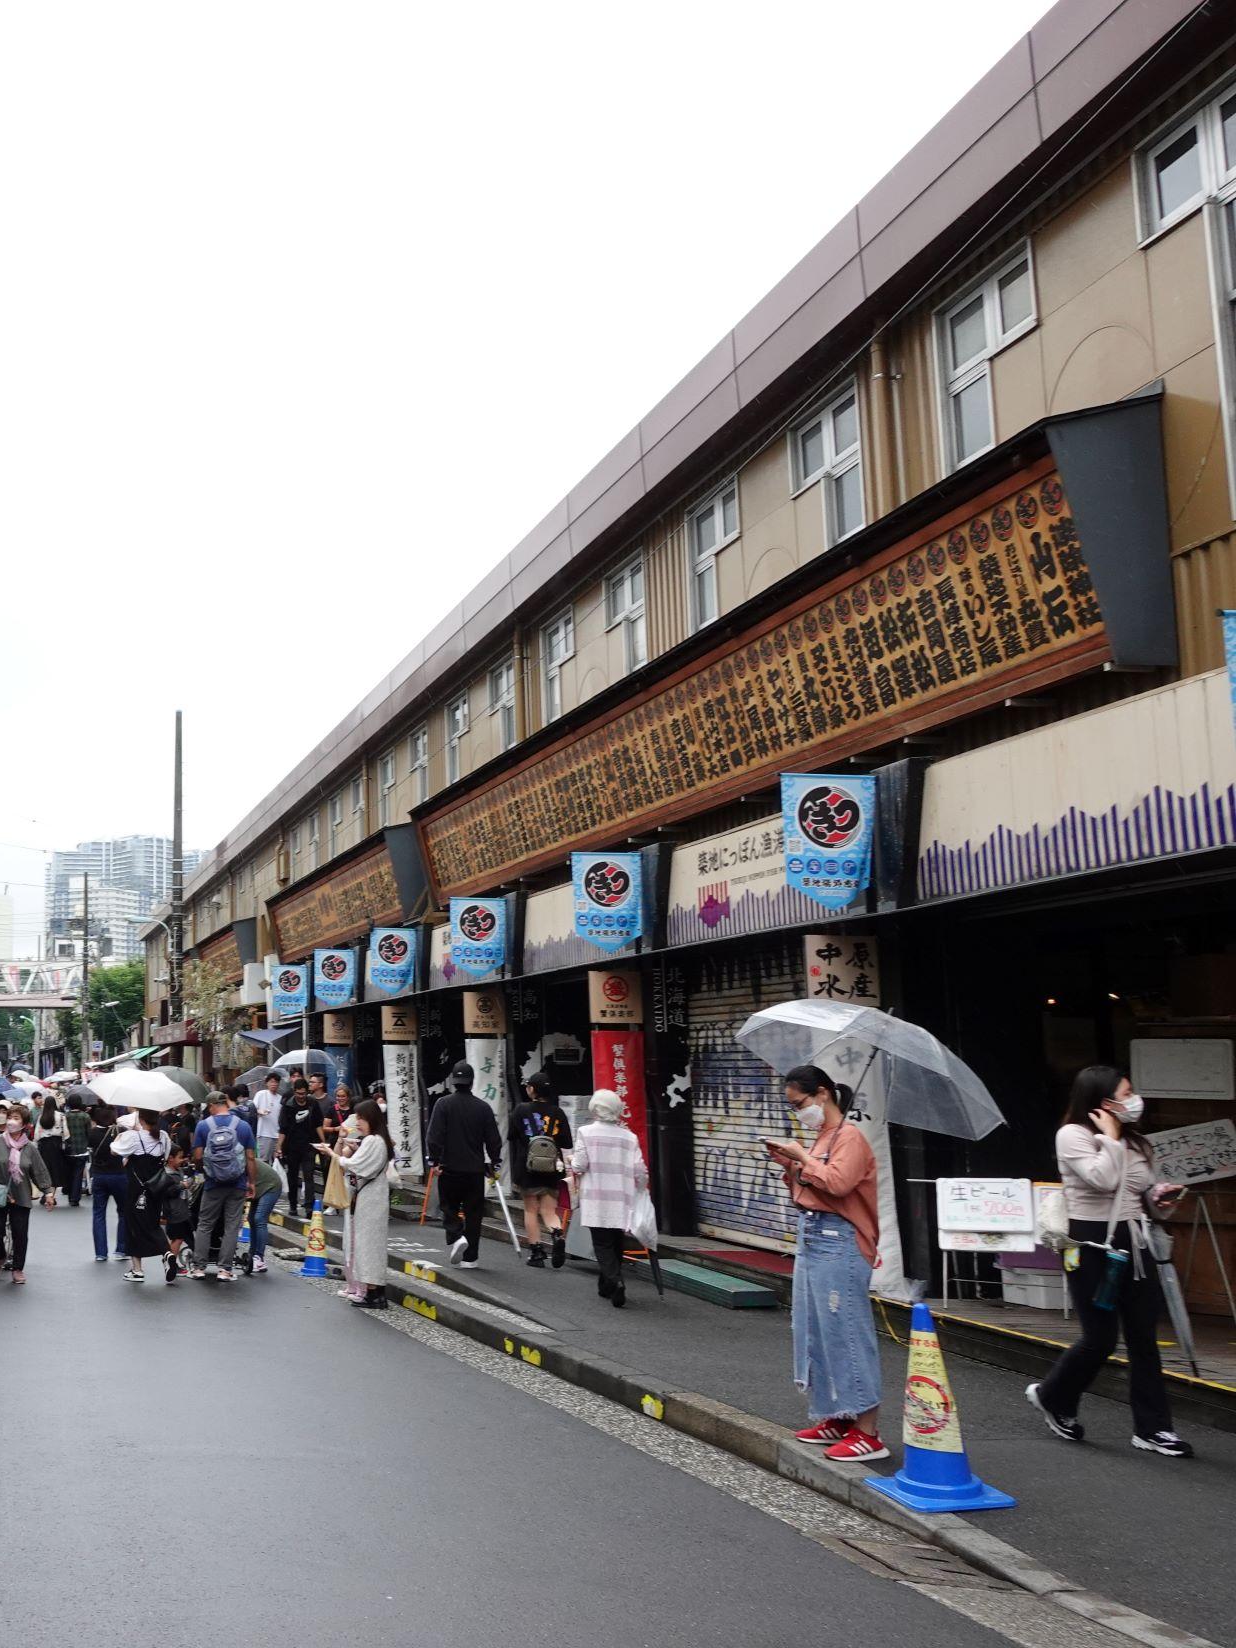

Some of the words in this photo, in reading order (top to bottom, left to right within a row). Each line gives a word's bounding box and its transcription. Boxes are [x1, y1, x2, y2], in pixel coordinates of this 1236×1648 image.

[667, 967, 688, 1028] 北海道
[951, 1184, 1016, 1201] 生ビール
